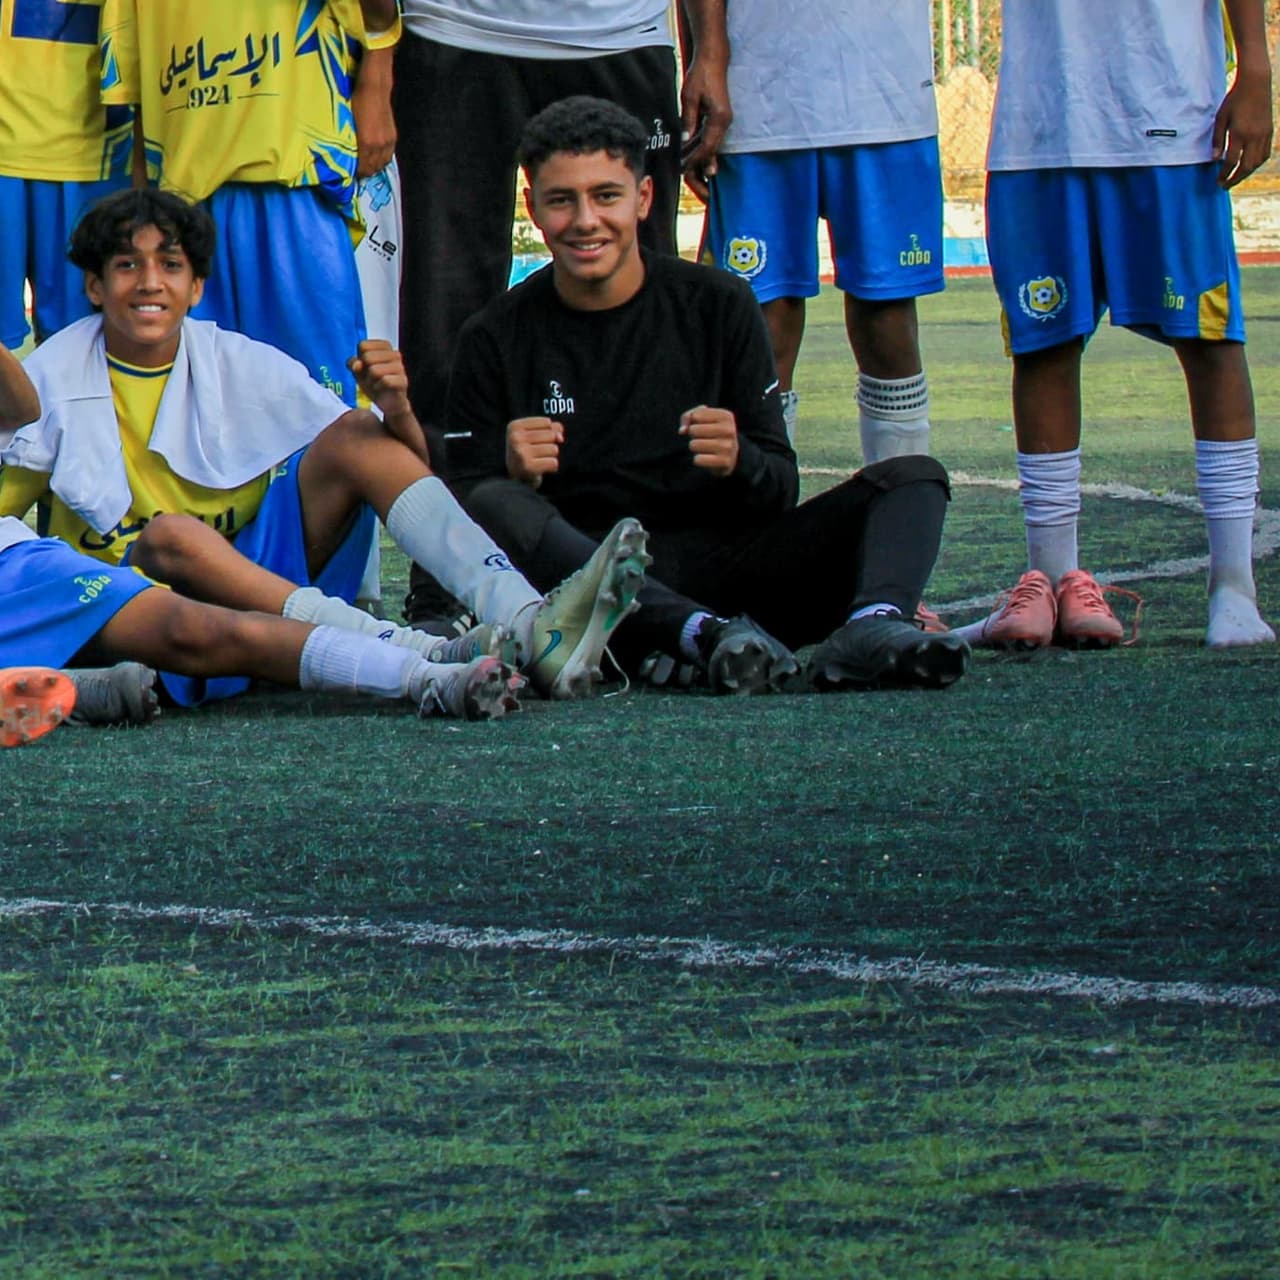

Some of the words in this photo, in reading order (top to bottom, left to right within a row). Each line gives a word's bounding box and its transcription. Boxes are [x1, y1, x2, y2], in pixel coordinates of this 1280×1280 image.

[899, 251, 932, 267] COPA
[543, 398, 575, 414] COPA
[78, 574, 113, 604] COPA
